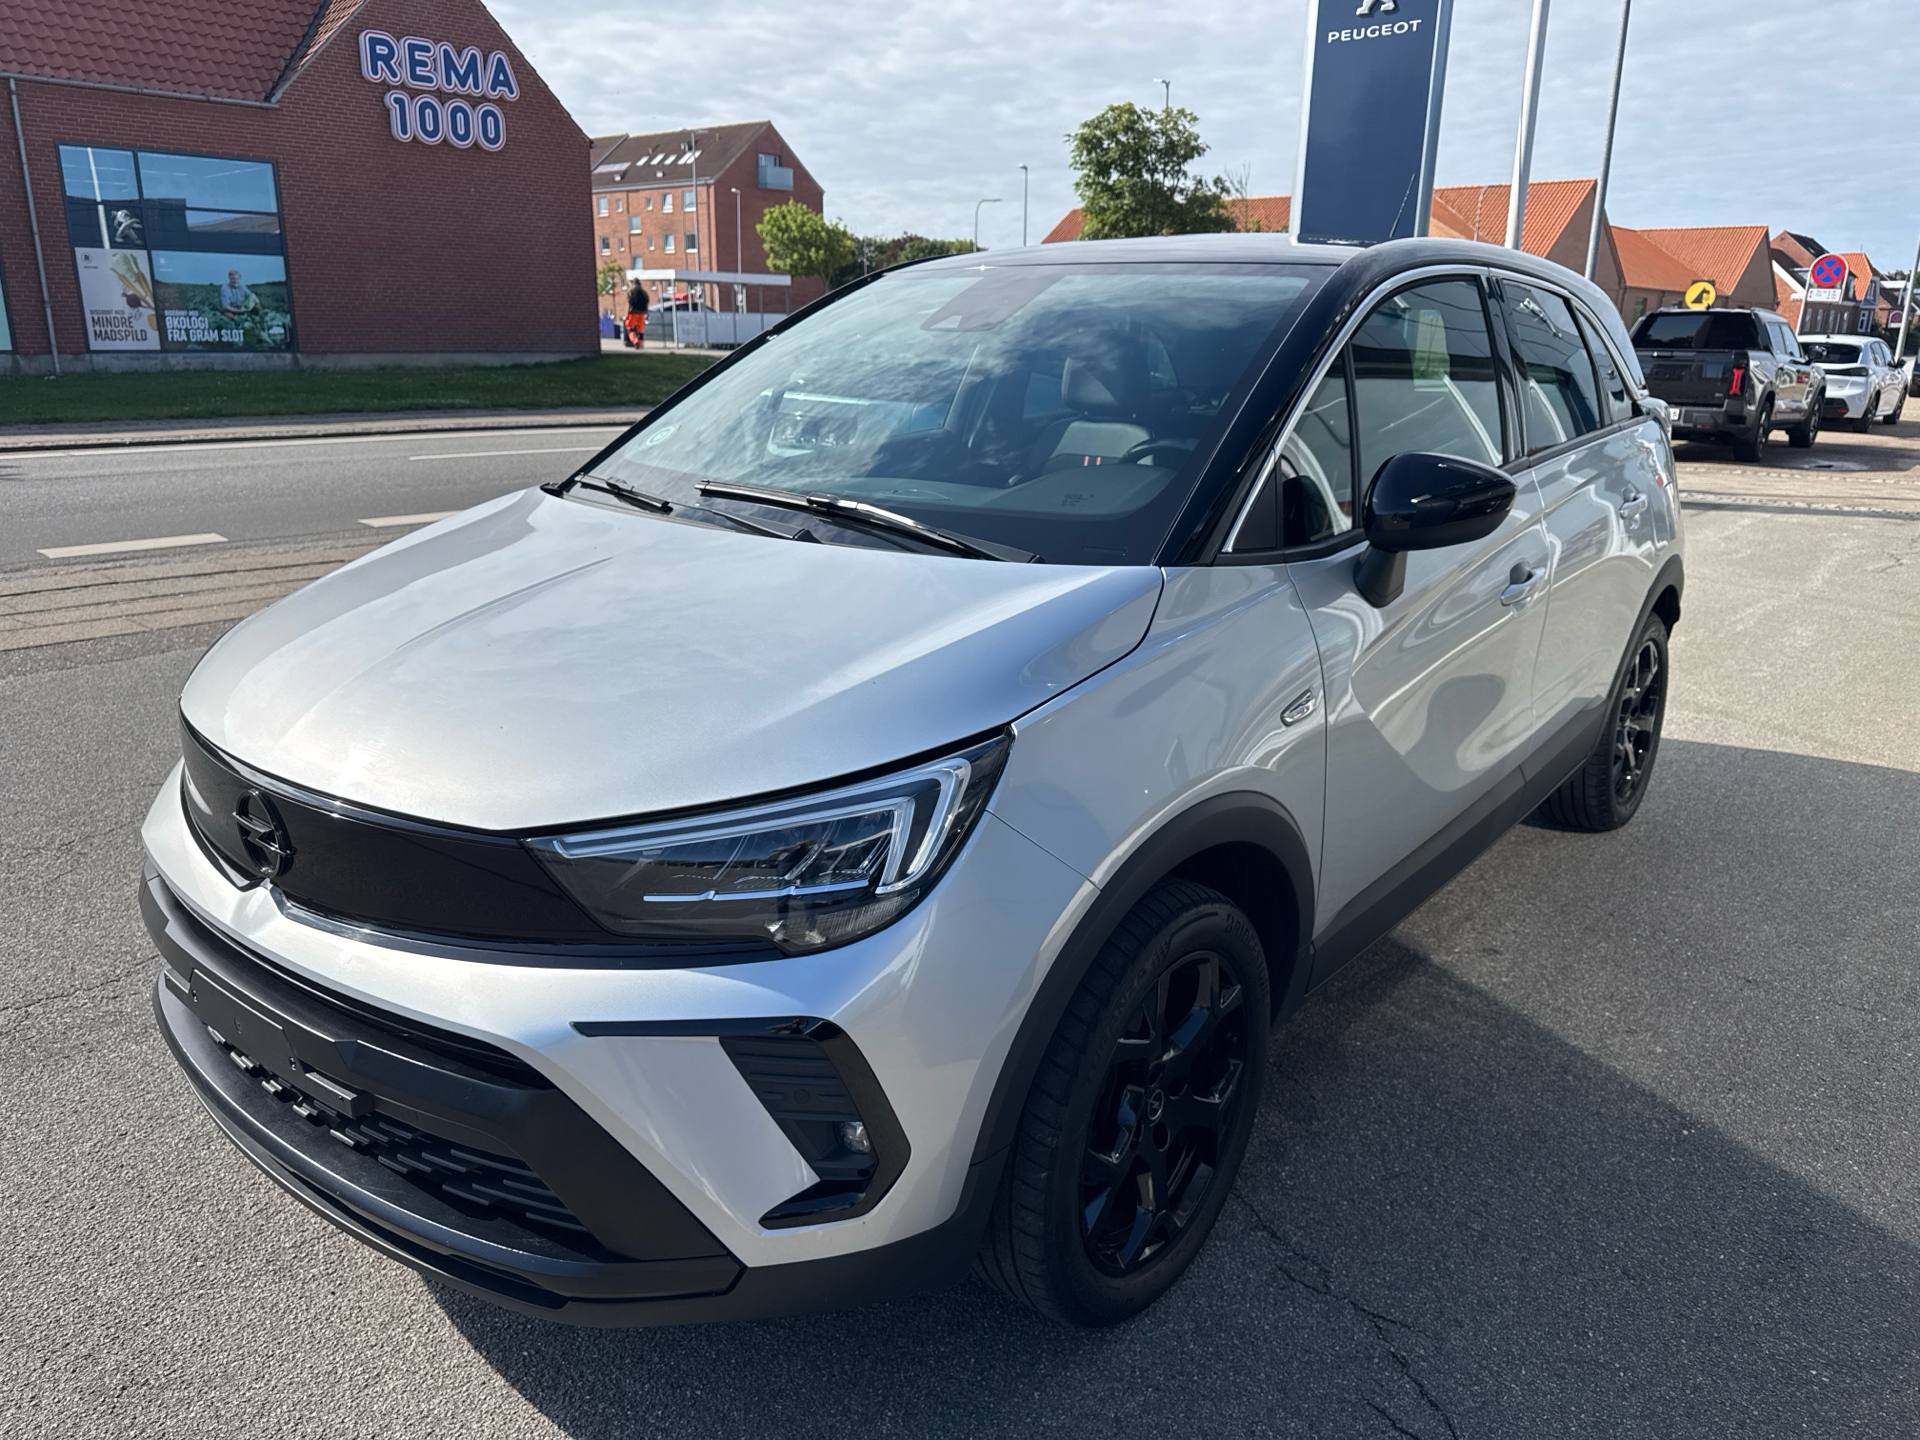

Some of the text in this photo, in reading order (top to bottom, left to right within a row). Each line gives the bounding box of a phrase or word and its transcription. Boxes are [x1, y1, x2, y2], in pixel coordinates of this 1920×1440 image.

[1327, 19, 1422, 44] PEUGEOT
[359, 29, 520, 101] REMA
[384, 90, 506, 151] 1000
[91, 315, 134, 329] MINDRE
[165, 316, 208, 329] ØKOLOGI
[93, 329, 147, 342] MADSPILD
[167, 329, 245, 342] FRA GRAM SLOT
